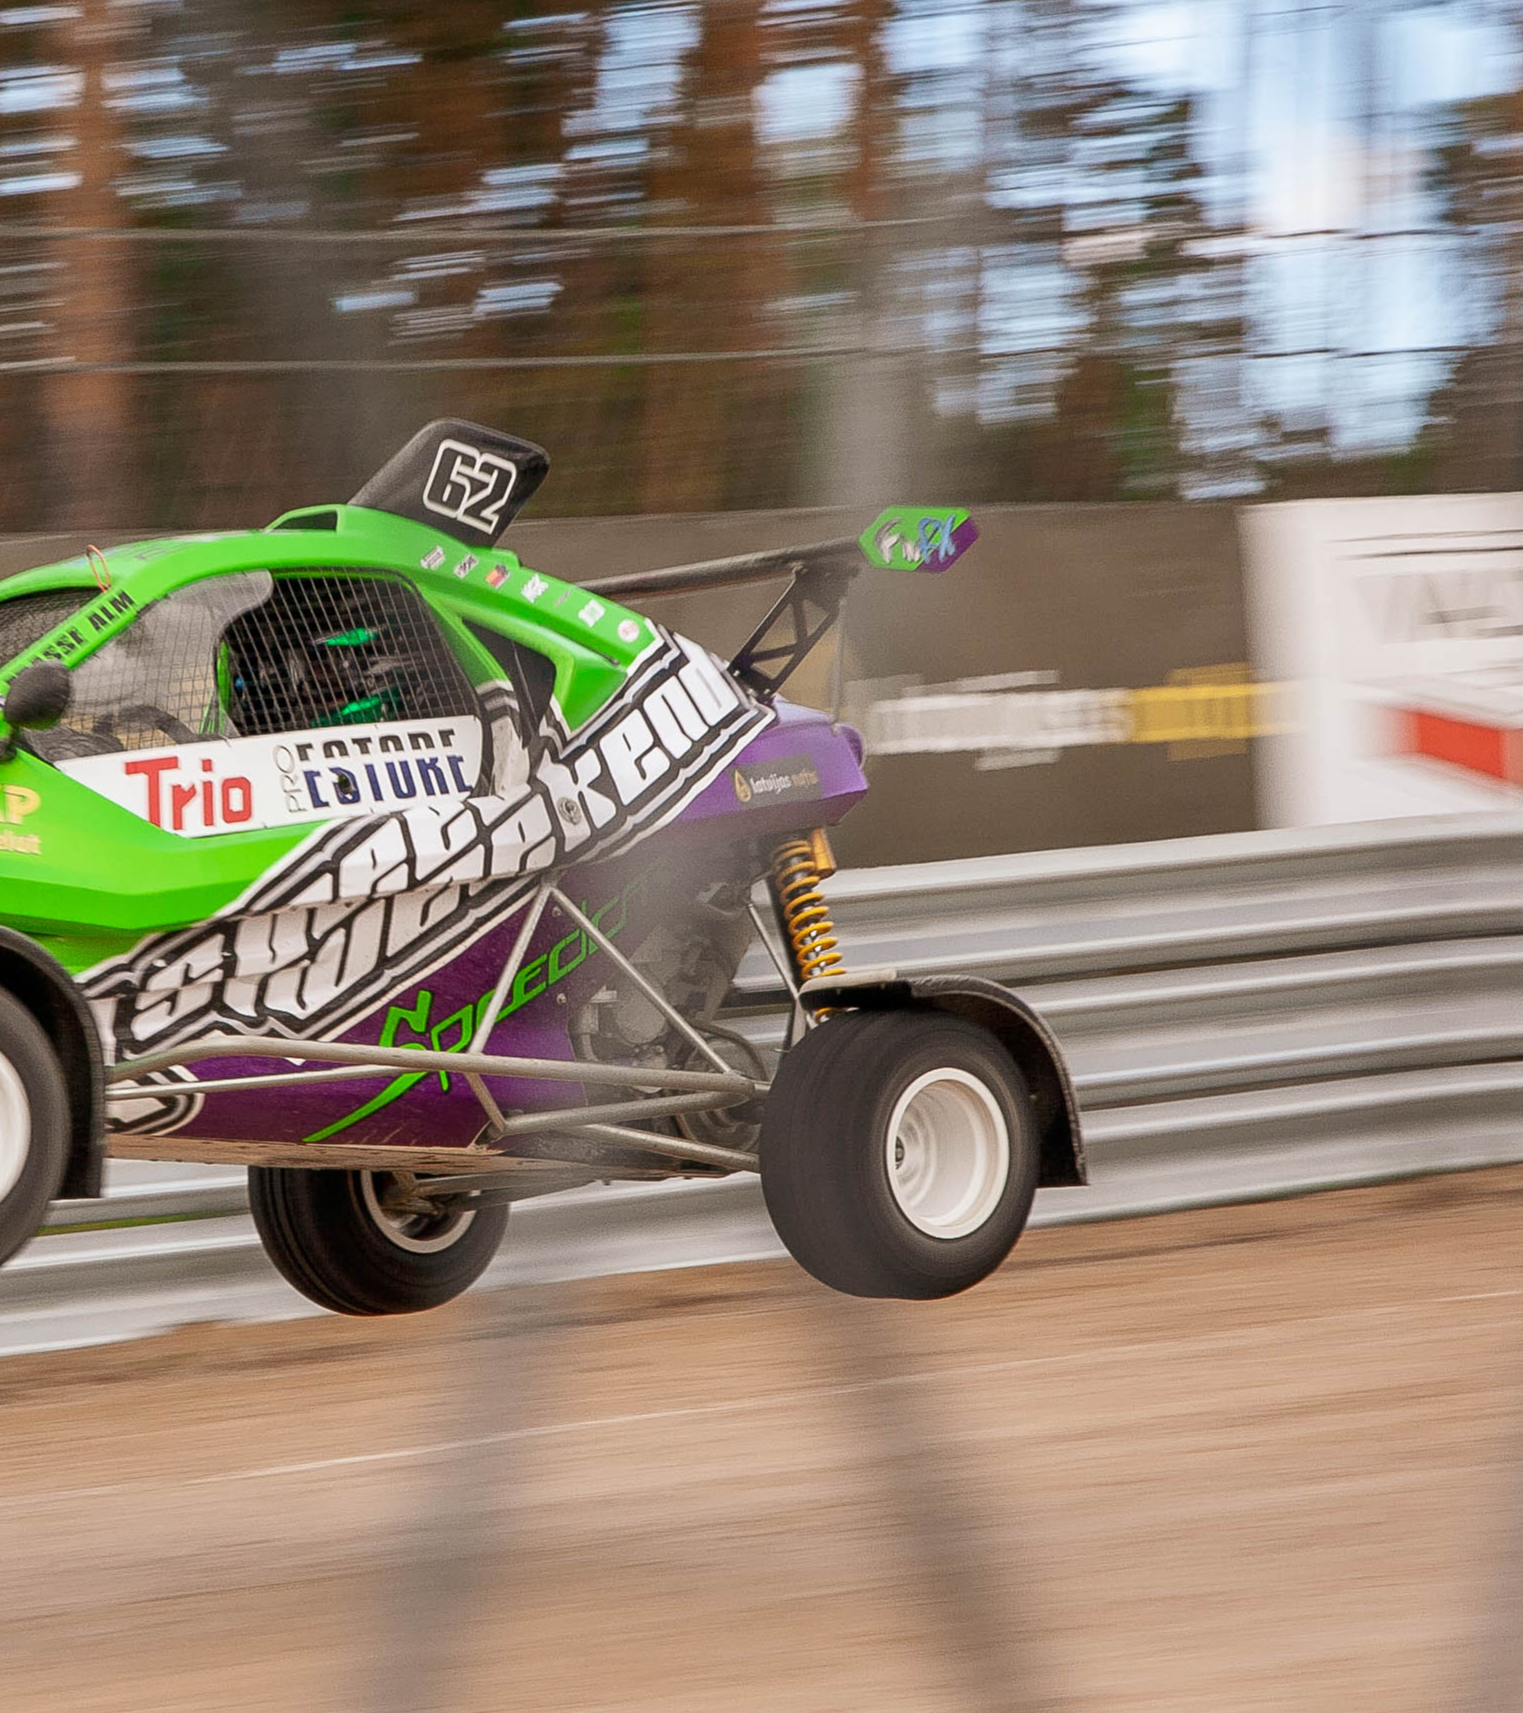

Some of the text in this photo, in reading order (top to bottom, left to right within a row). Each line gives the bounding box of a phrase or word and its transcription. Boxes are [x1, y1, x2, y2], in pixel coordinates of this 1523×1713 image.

[422, 438, 517, 535] 62
[88, 587, 137, 632] ALM
[123, 755, 252, 831] Trio
[272, 744, 307, 813] PRO
